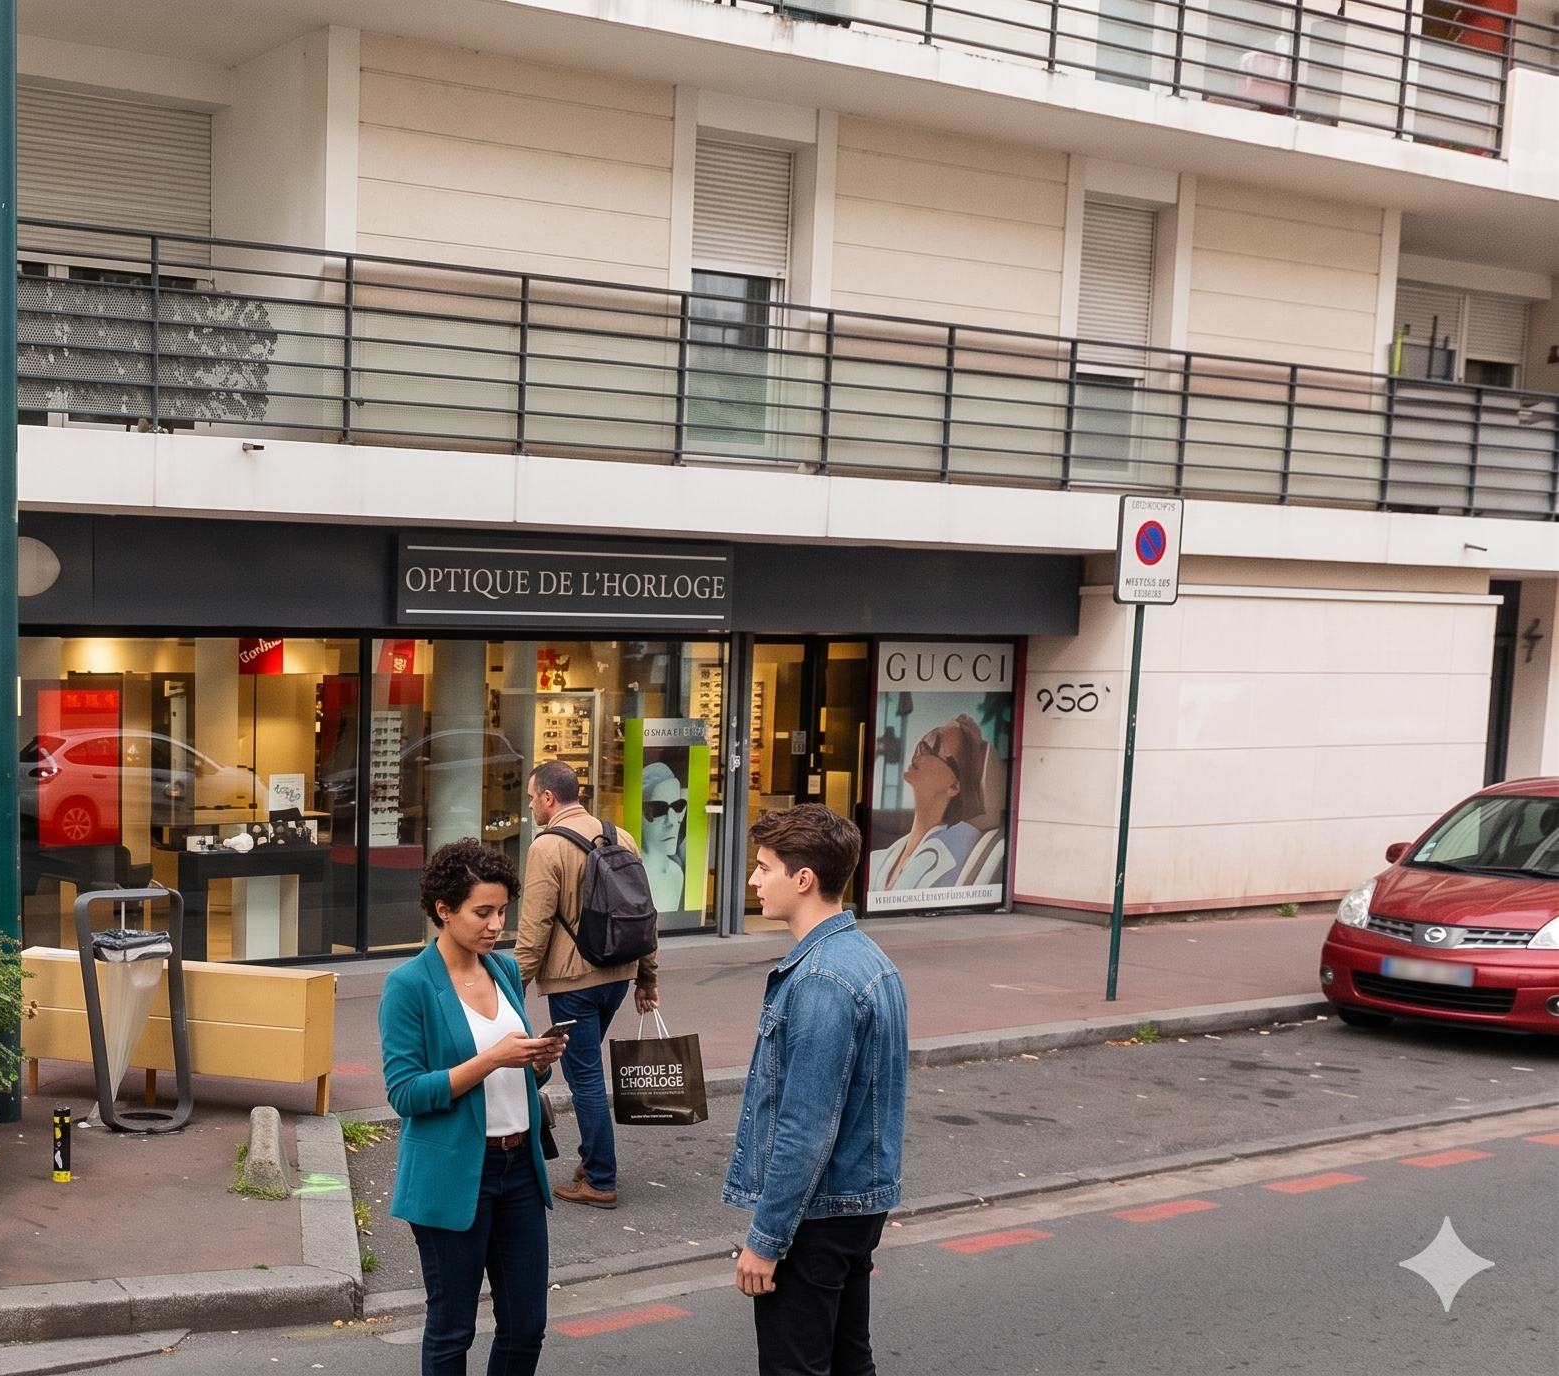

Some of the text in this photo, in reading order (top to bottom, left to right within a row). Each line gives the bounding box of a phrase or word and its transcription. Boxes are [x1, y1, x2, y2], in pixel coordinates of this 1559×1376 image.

[405, 566, 726, 600] OPTIQUE DE L'HORLOGE
[886, 652, 1006, 683] GUCCI
[620, 1063, 683, 1078] OPTIQUE DE
